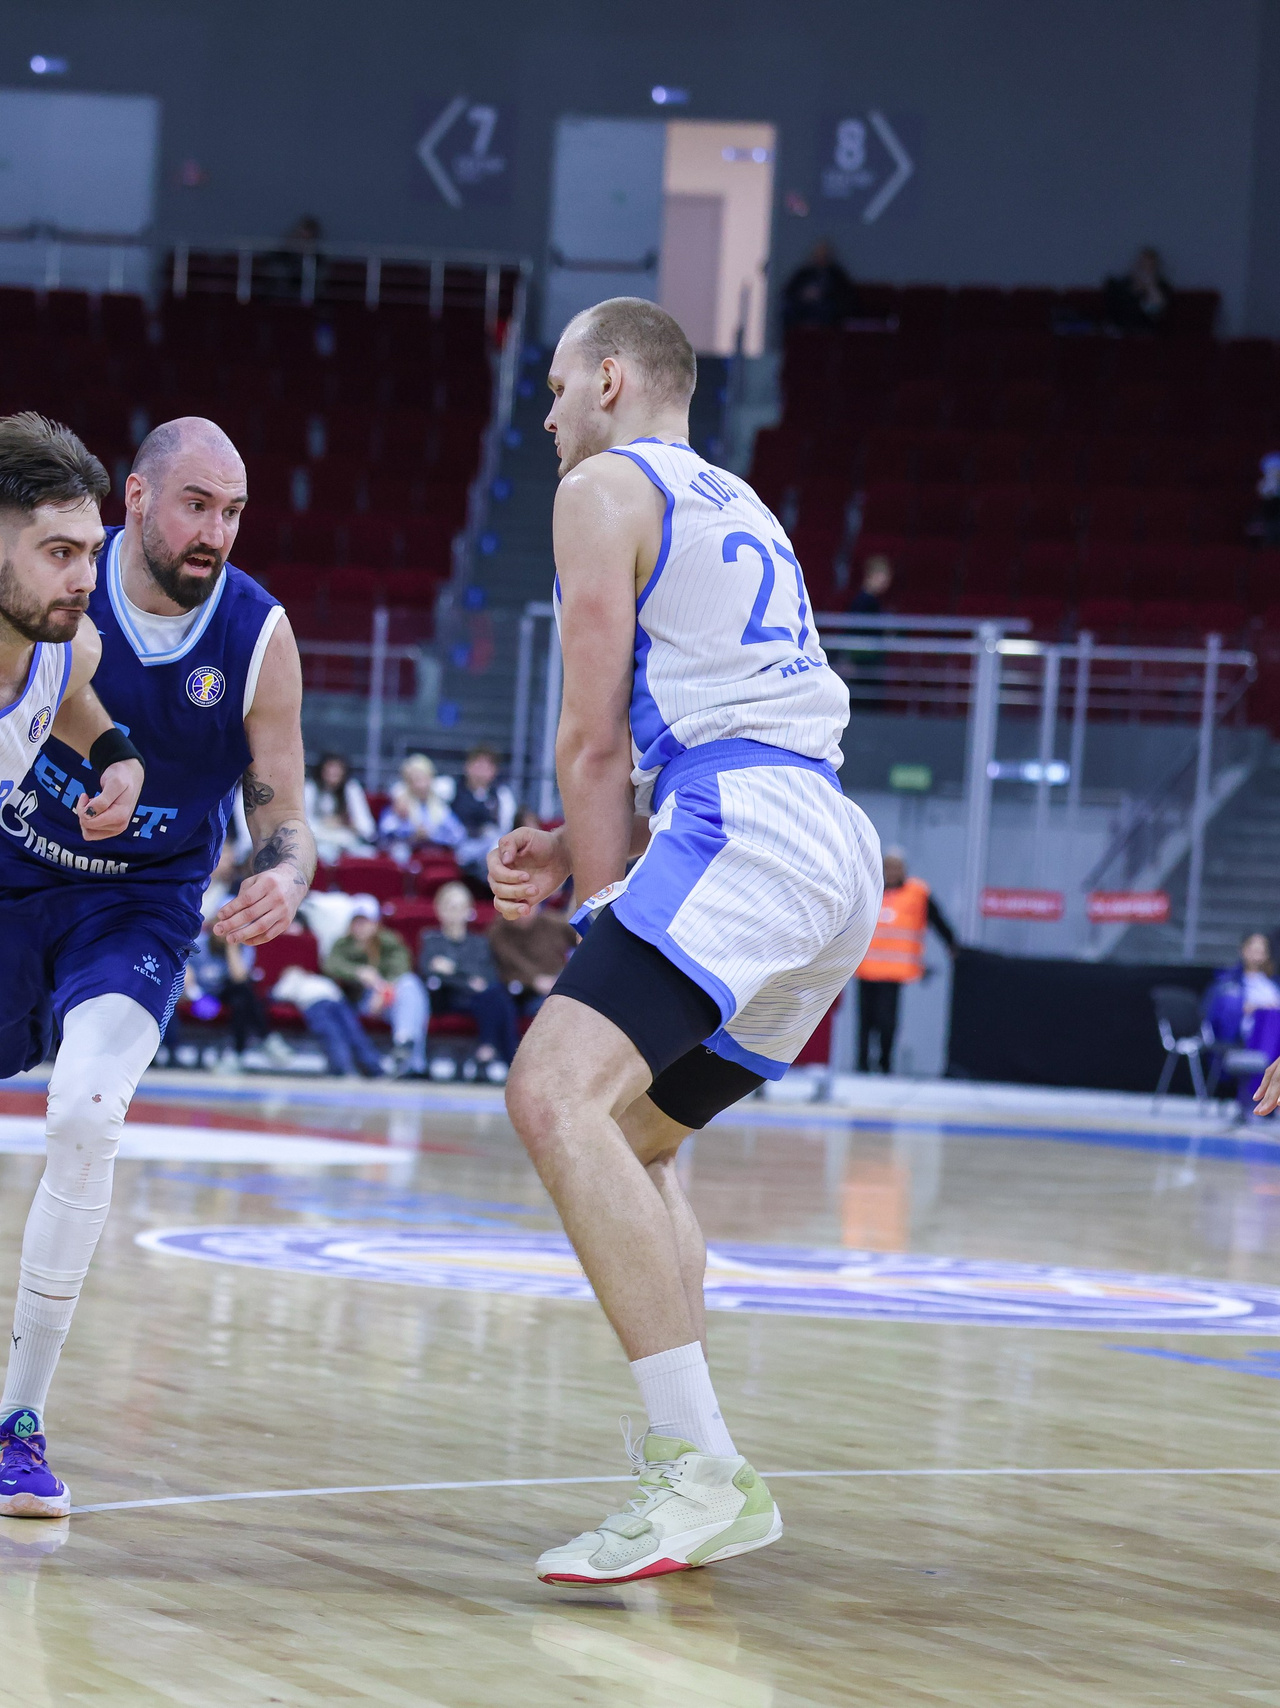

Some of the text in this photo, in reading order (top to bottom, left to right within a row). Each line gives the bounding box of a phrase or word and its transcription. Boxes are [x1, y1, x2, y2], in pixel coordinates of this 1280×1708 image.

[469, 106, 496, 158] 7
[835, 119, 865, 171] 8
[722, 531, 809, 651] 27
[24, 826, 129, 875] ГАЗПРОМ
[133, 964, 161, 986] KELME
